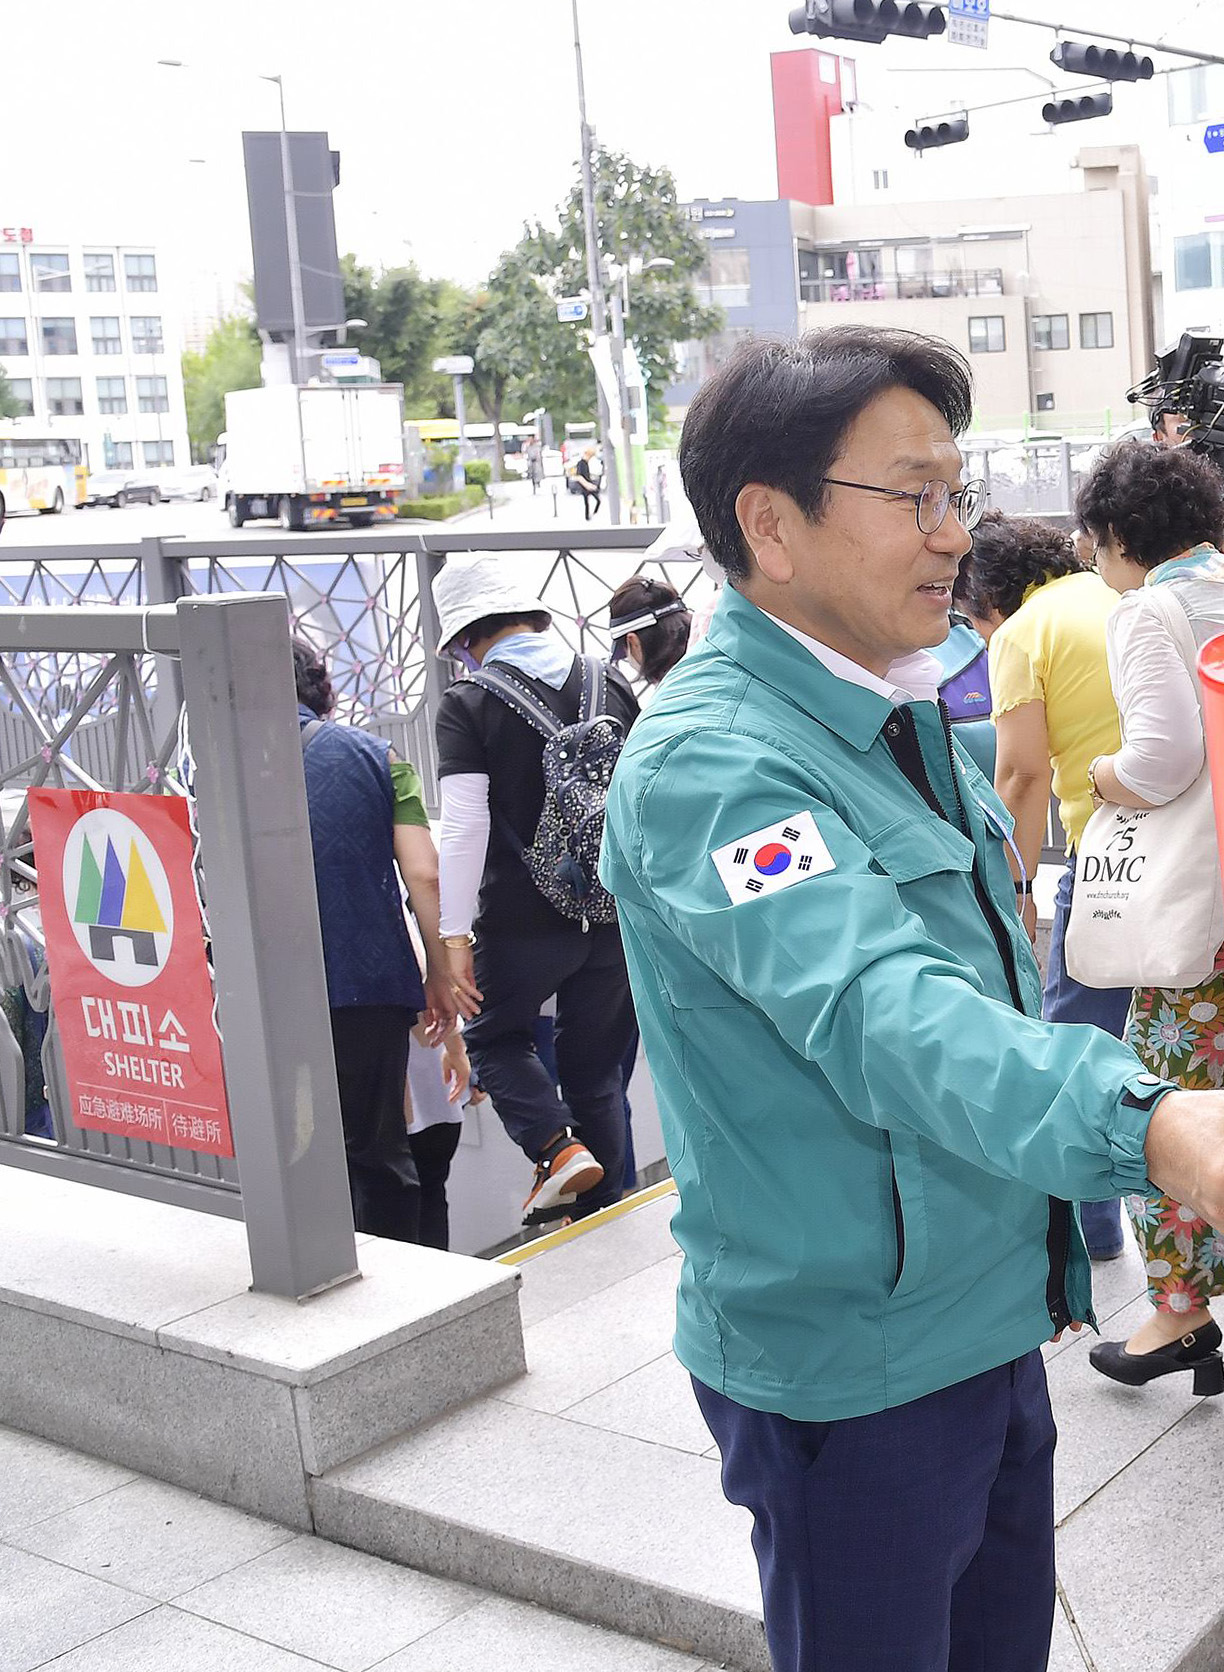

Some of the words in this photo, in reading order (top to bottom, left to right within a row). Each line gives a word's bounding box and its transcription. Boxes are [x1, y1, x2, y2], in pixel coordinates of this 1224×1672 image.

[1105, 825, 1138, 852] 75
[1081, 855, 1147, 883] DMC
[80, 995, 191, 1053] 대피소
[103, 1051, 186, 1089] SHELTER
[78, 1093, 163, 1132] 应急避难场所
[171, 1112, 222, 1145] 待避所
